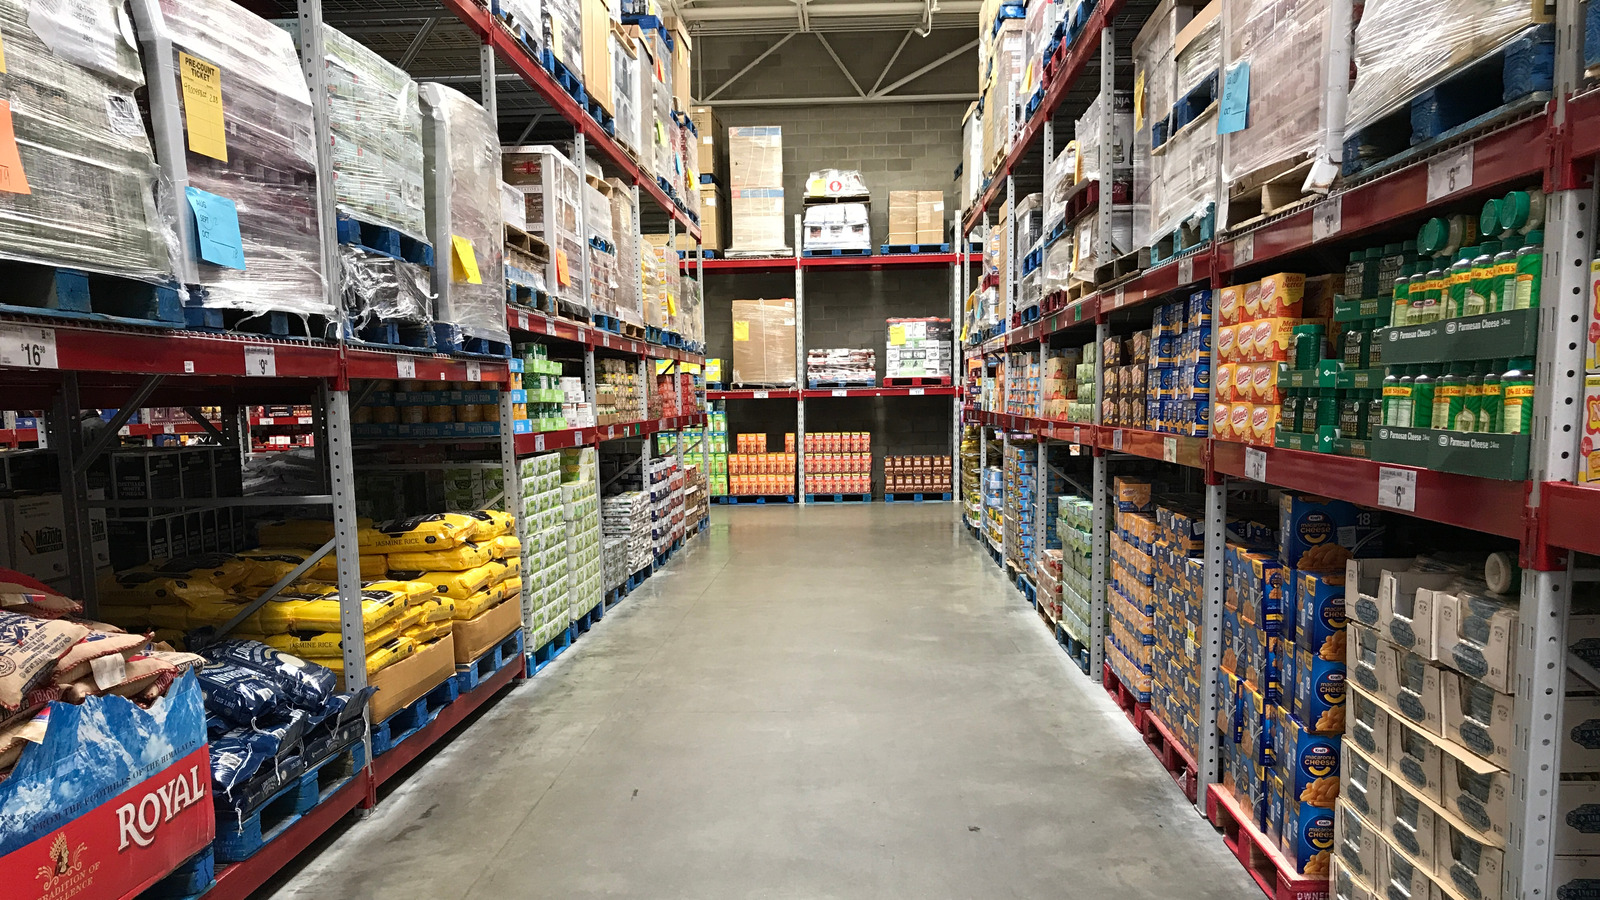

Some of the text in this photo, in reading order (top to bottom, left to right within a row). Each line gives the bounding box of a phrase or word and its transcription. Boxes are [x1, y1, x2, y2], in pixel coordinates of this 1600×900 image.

[185, 57, 215, 76] PRE-COUNT
[191, 68, 210, 82] TICKET
[1113, 96, 1131, 107] NJA
[1281, 281, 1304, 289] better
[1278, 325, 1293, 333] bett
[1458, 322, 1481, 331] Parmesan
[1482, 320, 1500, 328] Cheese
[1400, 331, 1417, 339] Parmesan
[1417, 329, 1431, 337] Cheese
[1390, 431, 1408, 440] Parmesan
[1408, 432, 1422, 441] Cheese
[1450, 439, 1470, 448] Parmesan
[1471, 439, 1489, 449] Cheese
[1356, 513, 1371, 525] 18
[375, 539, 402, 547] JASMINE
[33, 812, 62, 833] FROM
[63, 803, 82, 816] THE
[84, 777, 131, 805] FOOTHILLS
[143, 760, 160, 773] THE
[160, 739, 196, 764] HIMALAYAS
[116, 765, 205, 852] ROYAL
[88, 861, 101, 874] OF
